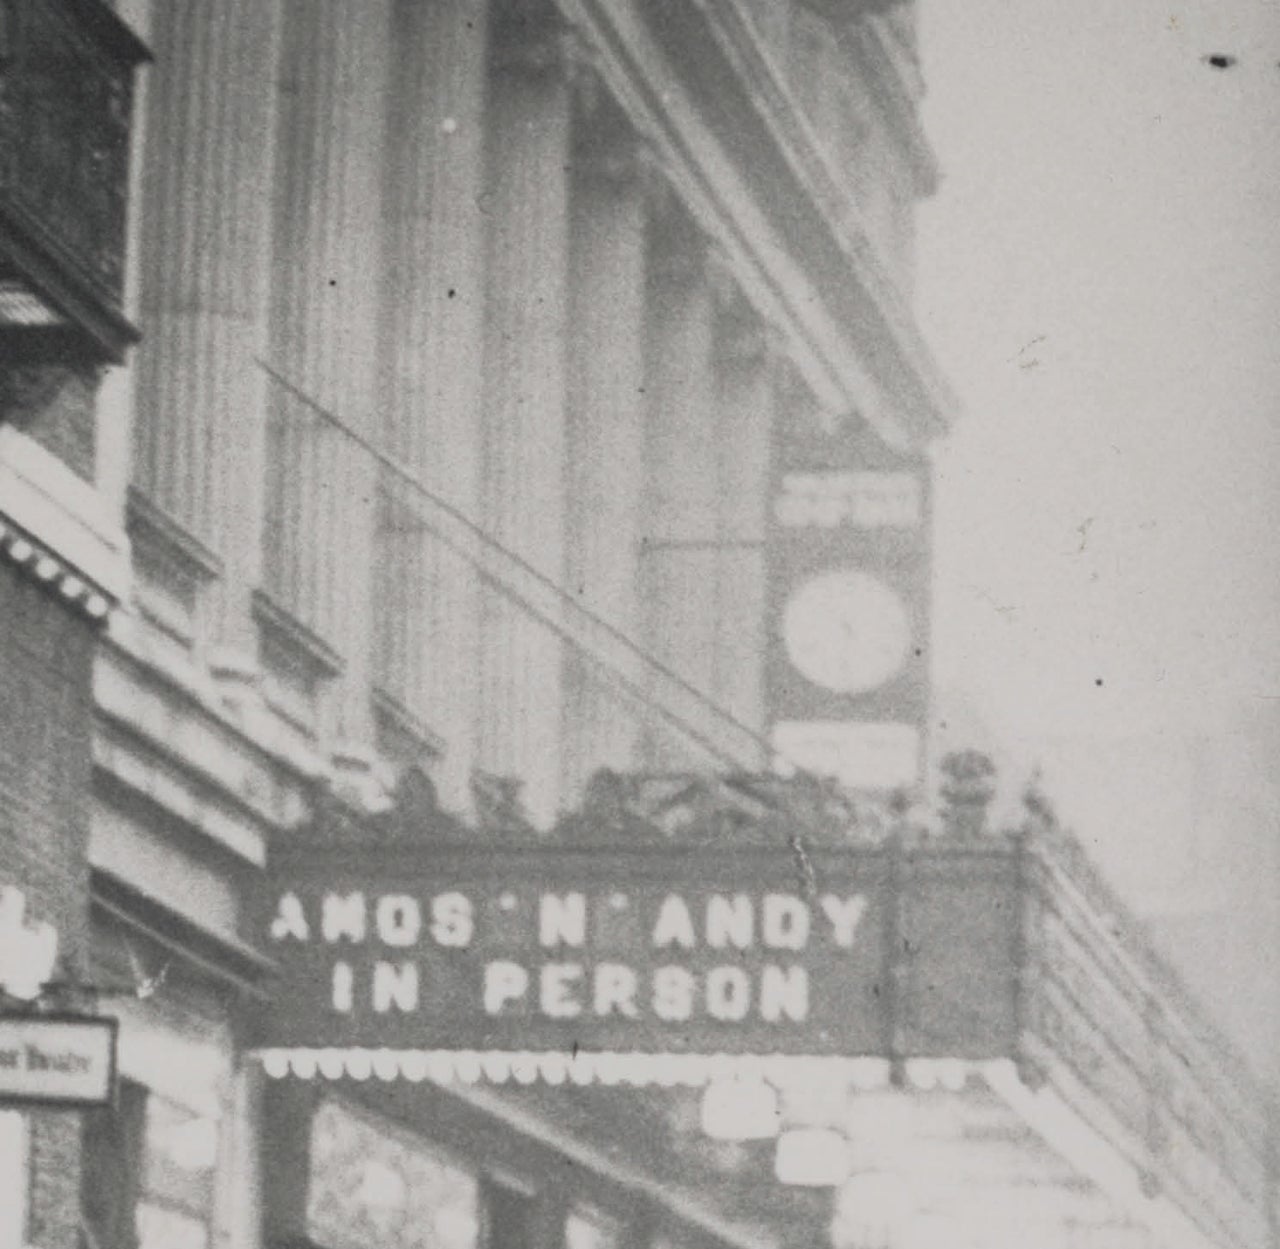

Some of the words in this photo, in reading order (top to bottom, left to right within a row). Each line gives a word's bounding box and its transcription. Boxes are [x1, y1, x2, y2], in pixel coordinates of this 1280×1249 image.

[270, 890, 474, 947] AMOS
[651, 891, 865, 949] ANDY
[332, 960, 421, 1013] IN
[483, 961, 810, 1022] PERSON
